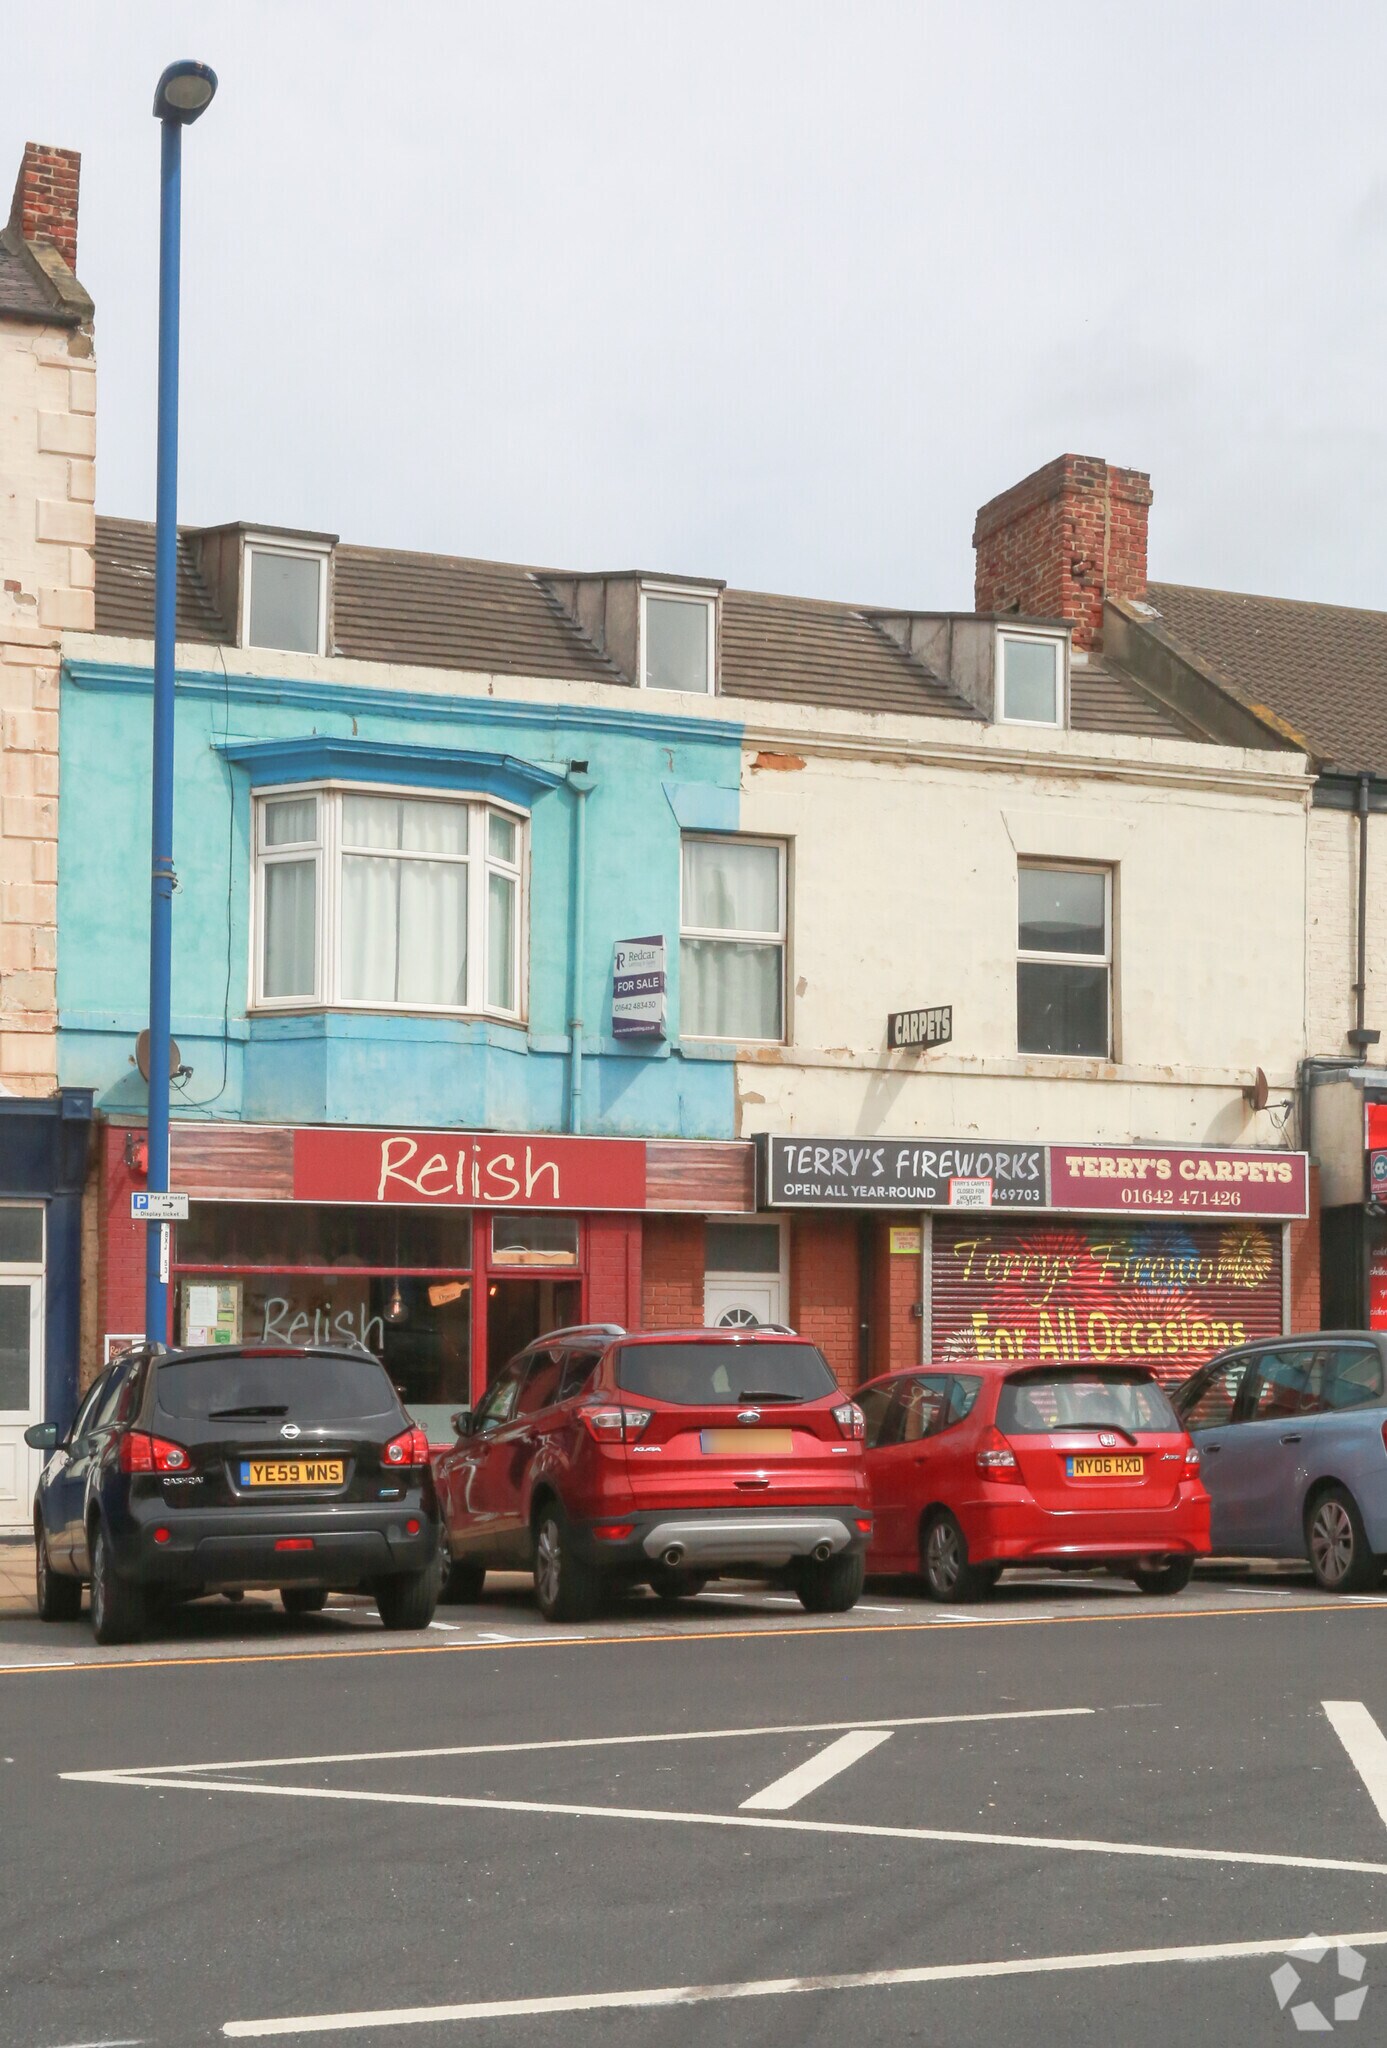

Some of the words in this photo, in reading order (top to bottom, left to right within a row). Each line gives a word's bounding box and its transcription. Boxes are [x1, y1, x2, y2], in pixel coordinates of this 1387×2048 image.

[628, 949, 656, 962] Redcar
[617, 980, 634, 992] FOR
[636, 977, 659, 989] SALE
[614, 1003, 632, 1012] 01642
[894, 1008, 950, 1045] CARPETS
[377, 1136, 560, 1201] Relish
[783, 1145, 885, 1177] TERRY'S
[896, 1149, 1040, 1181] FIREWORKS
[1065, 1156, 1172, 1181] TERRY'S
[1179, 1159, 1293, 1184] CARPETS
[783, 1183, 821, 1196] OPEN
[824, 1185, 848, 1197] ALL
[850, 1185, 936, 1199] YEAR-ROUND
[991, 1188, 1040, 1201] 469703
[1121, 1188, 1174, 1205] 01642
[1179, 1191, 1241, 1207] 471426
[263, 1297, 384, 1349] Relish
[971, 1312, 1027, 1360] For
[1039, 1308, 1080, 1360] All
[1087, 1309, 1248, 1361] Occasions
[253, 1465, 300, 1482] YE59
[305, 1464, 340, 1481] WNS
[1076, 1459, 1111, 1473] NY06
[1115, 1458, 1141, 1472] HXD
